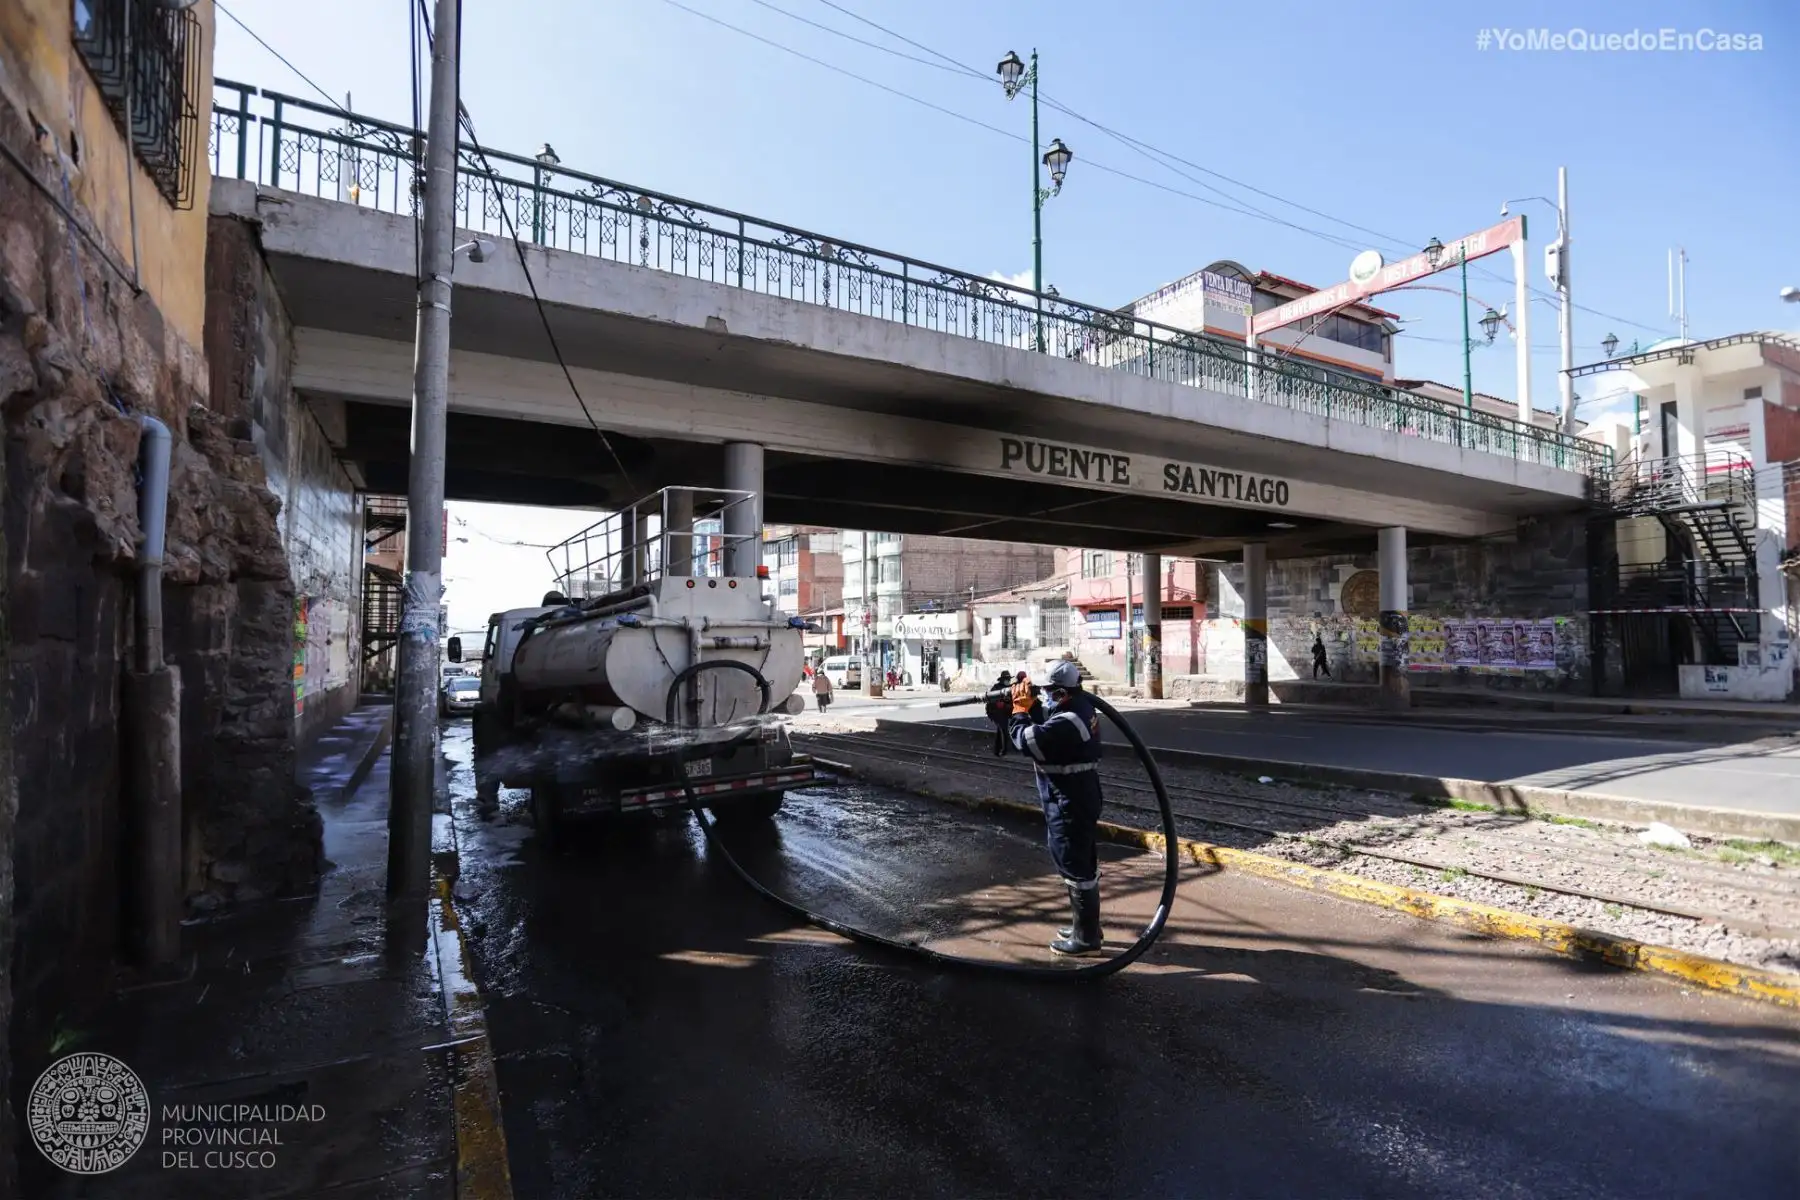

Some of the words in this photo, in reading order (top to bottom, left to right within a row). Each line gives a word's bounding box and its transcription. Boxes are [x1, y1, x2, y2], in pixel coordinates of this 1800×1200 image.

[1204, 271, 1225, 290] VENTA
[1225, 277, 1234, 293] DE
[1234, 280, 1252, 298] LOTES
[999, 437, 1130, 486] PUENTE
[1163, 463, 1289, 506] SANTIAGO
[906, 624, 927, 635] BANCO
[928, 625, 952, 636] AZTECA
